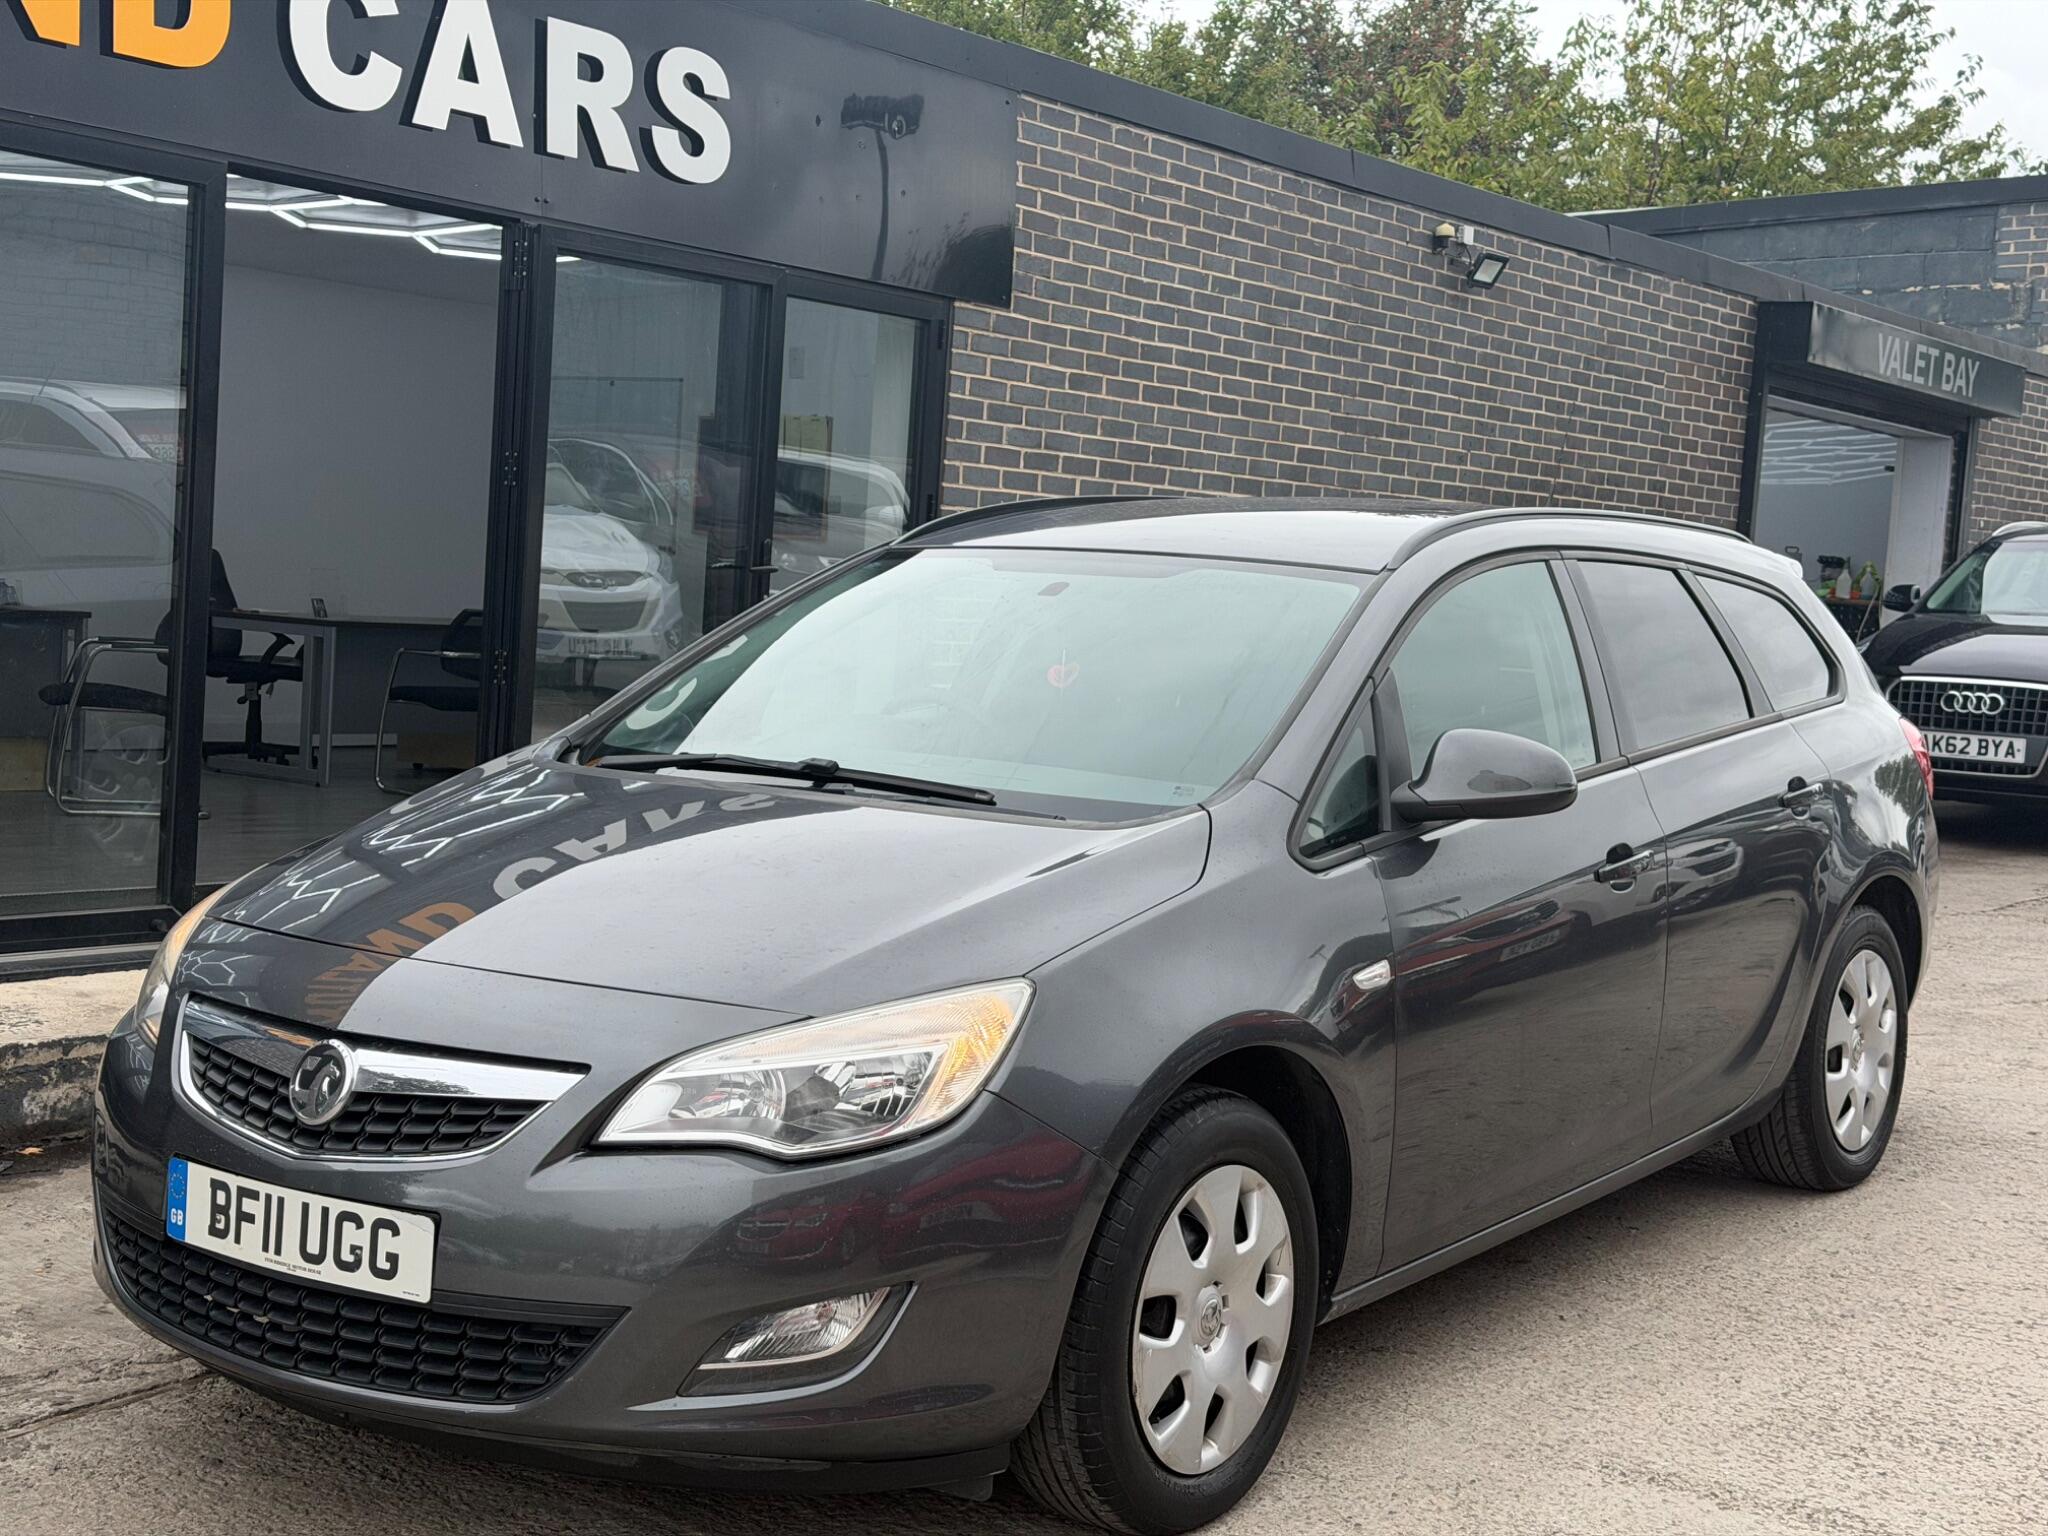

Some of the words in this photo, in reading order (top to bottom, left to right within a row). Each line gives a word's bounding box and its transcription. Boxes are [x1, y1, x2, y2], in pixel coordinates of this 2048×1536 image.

[288, 0, 731, 184] CARS
[1878, 332, 1940, 387] VALET
[1941, 351, 1981, 398] BAY
[1976, 738, 2016, 759] BYA
[170, 1207, 184, 1226] GB
[208, 1177, 285, 1257] BF11
[299, 1201, 401, 1281] UGG
